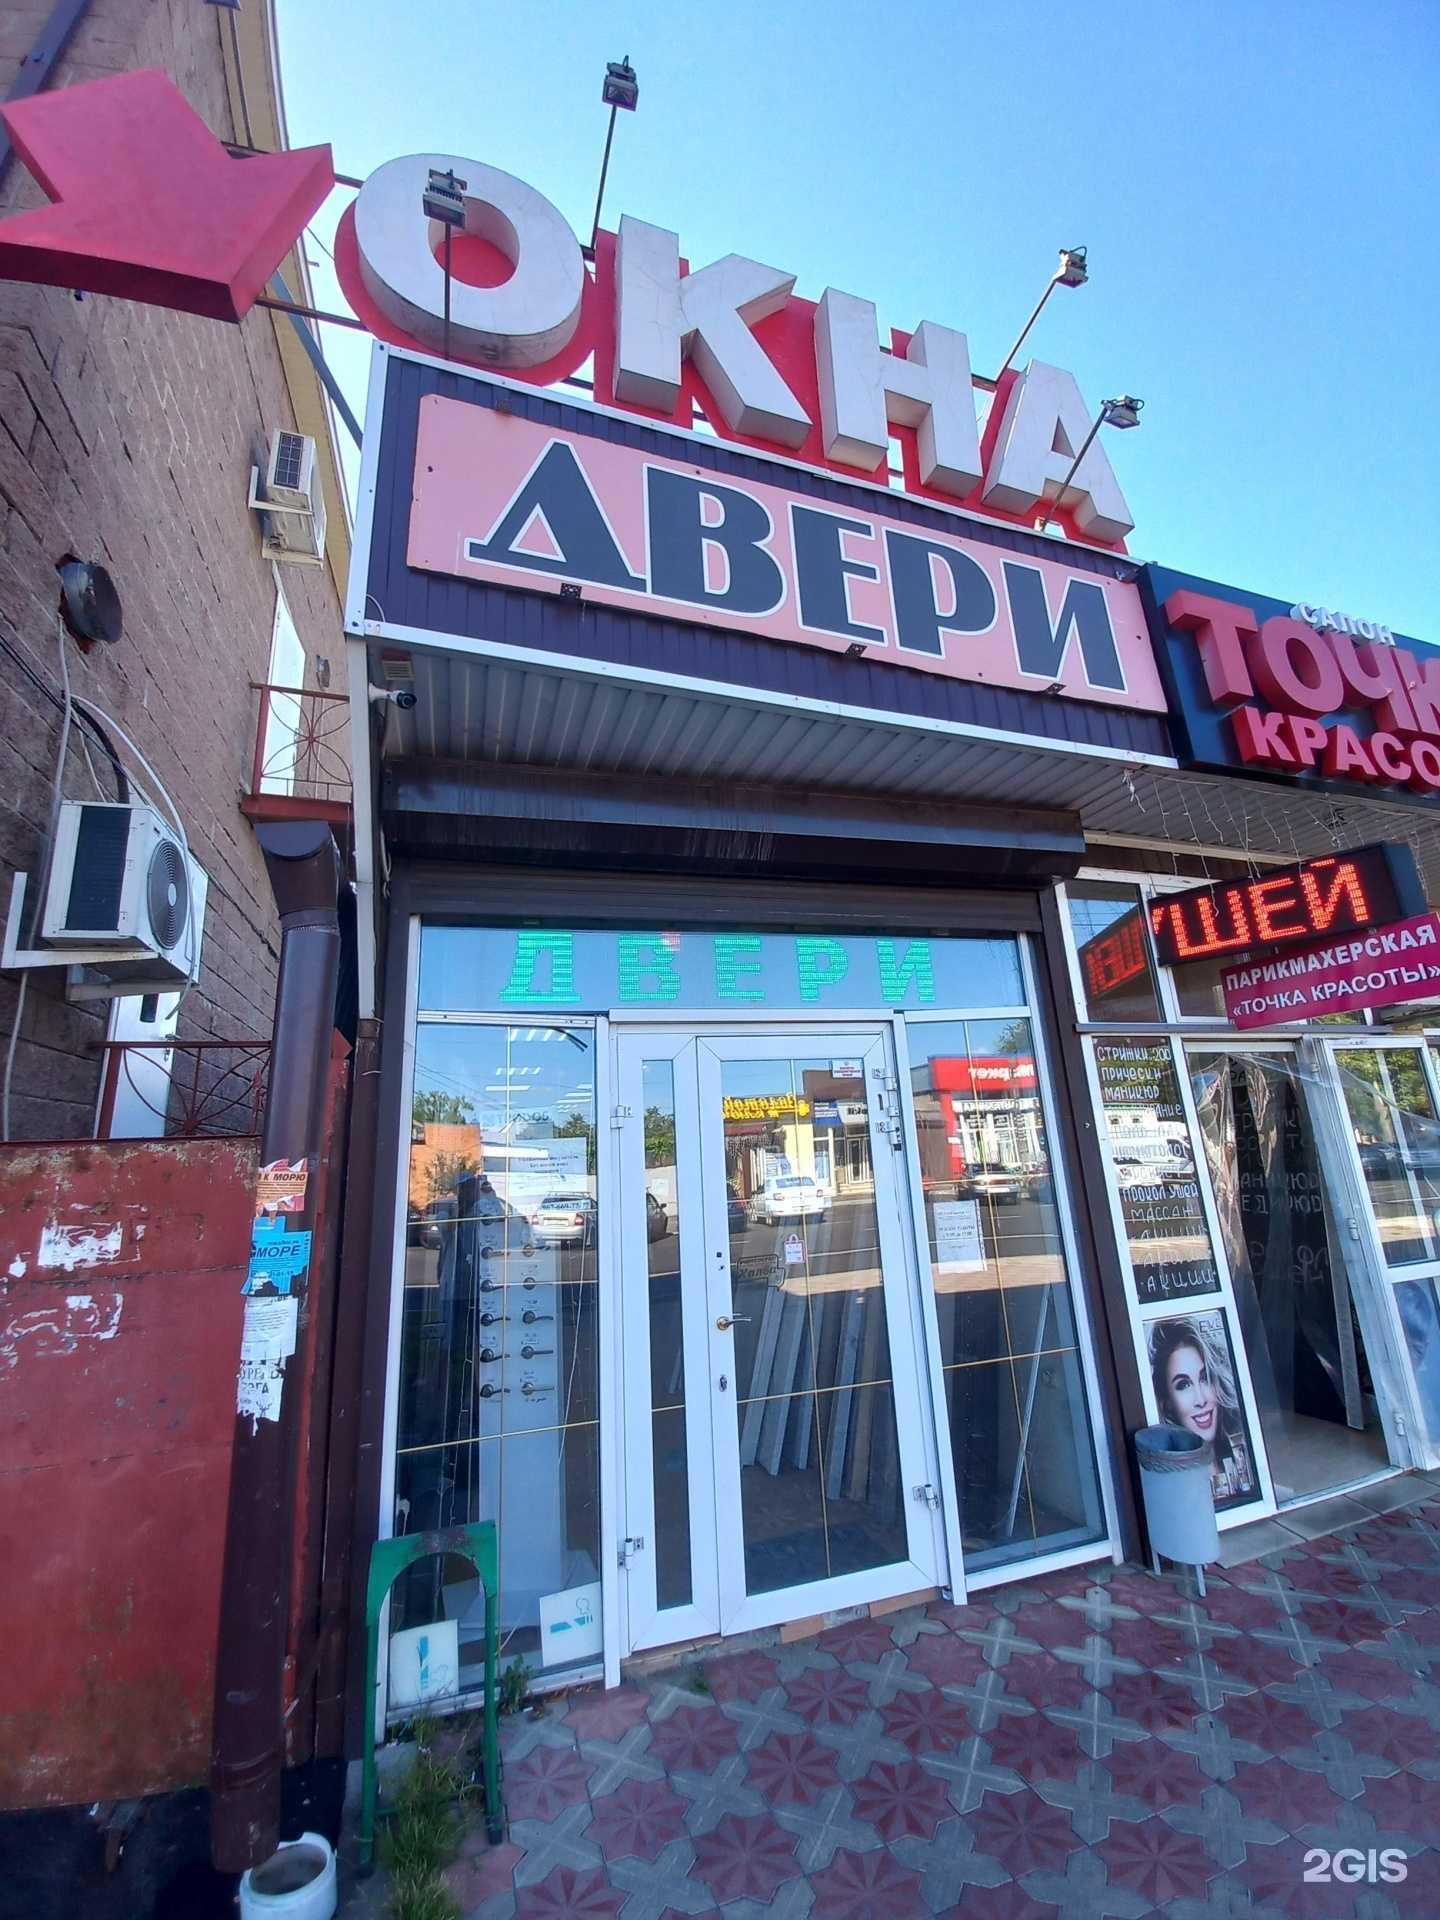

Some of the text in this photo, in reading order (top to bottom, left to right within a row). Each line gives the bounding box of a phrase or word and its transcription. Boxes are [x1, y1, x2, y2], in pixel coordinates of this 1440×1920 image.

[345, 152, 1135, 546] ОКНА
[464, 438, 1129, 695] ДВЕРИ
[1290, 602, 1396, 648] САЛОН
[499, 932, 936, 1002] ДВЕРИ
[1226, 924, 1437, 991] ПАРИКМАХЕРСКАЯ
[1232, 991, 1307, 1017] «ТОЧКА
[273, 1173, 306, 1182] МОРЮ
[255, 1244, 302, 1258] МОРЕ
